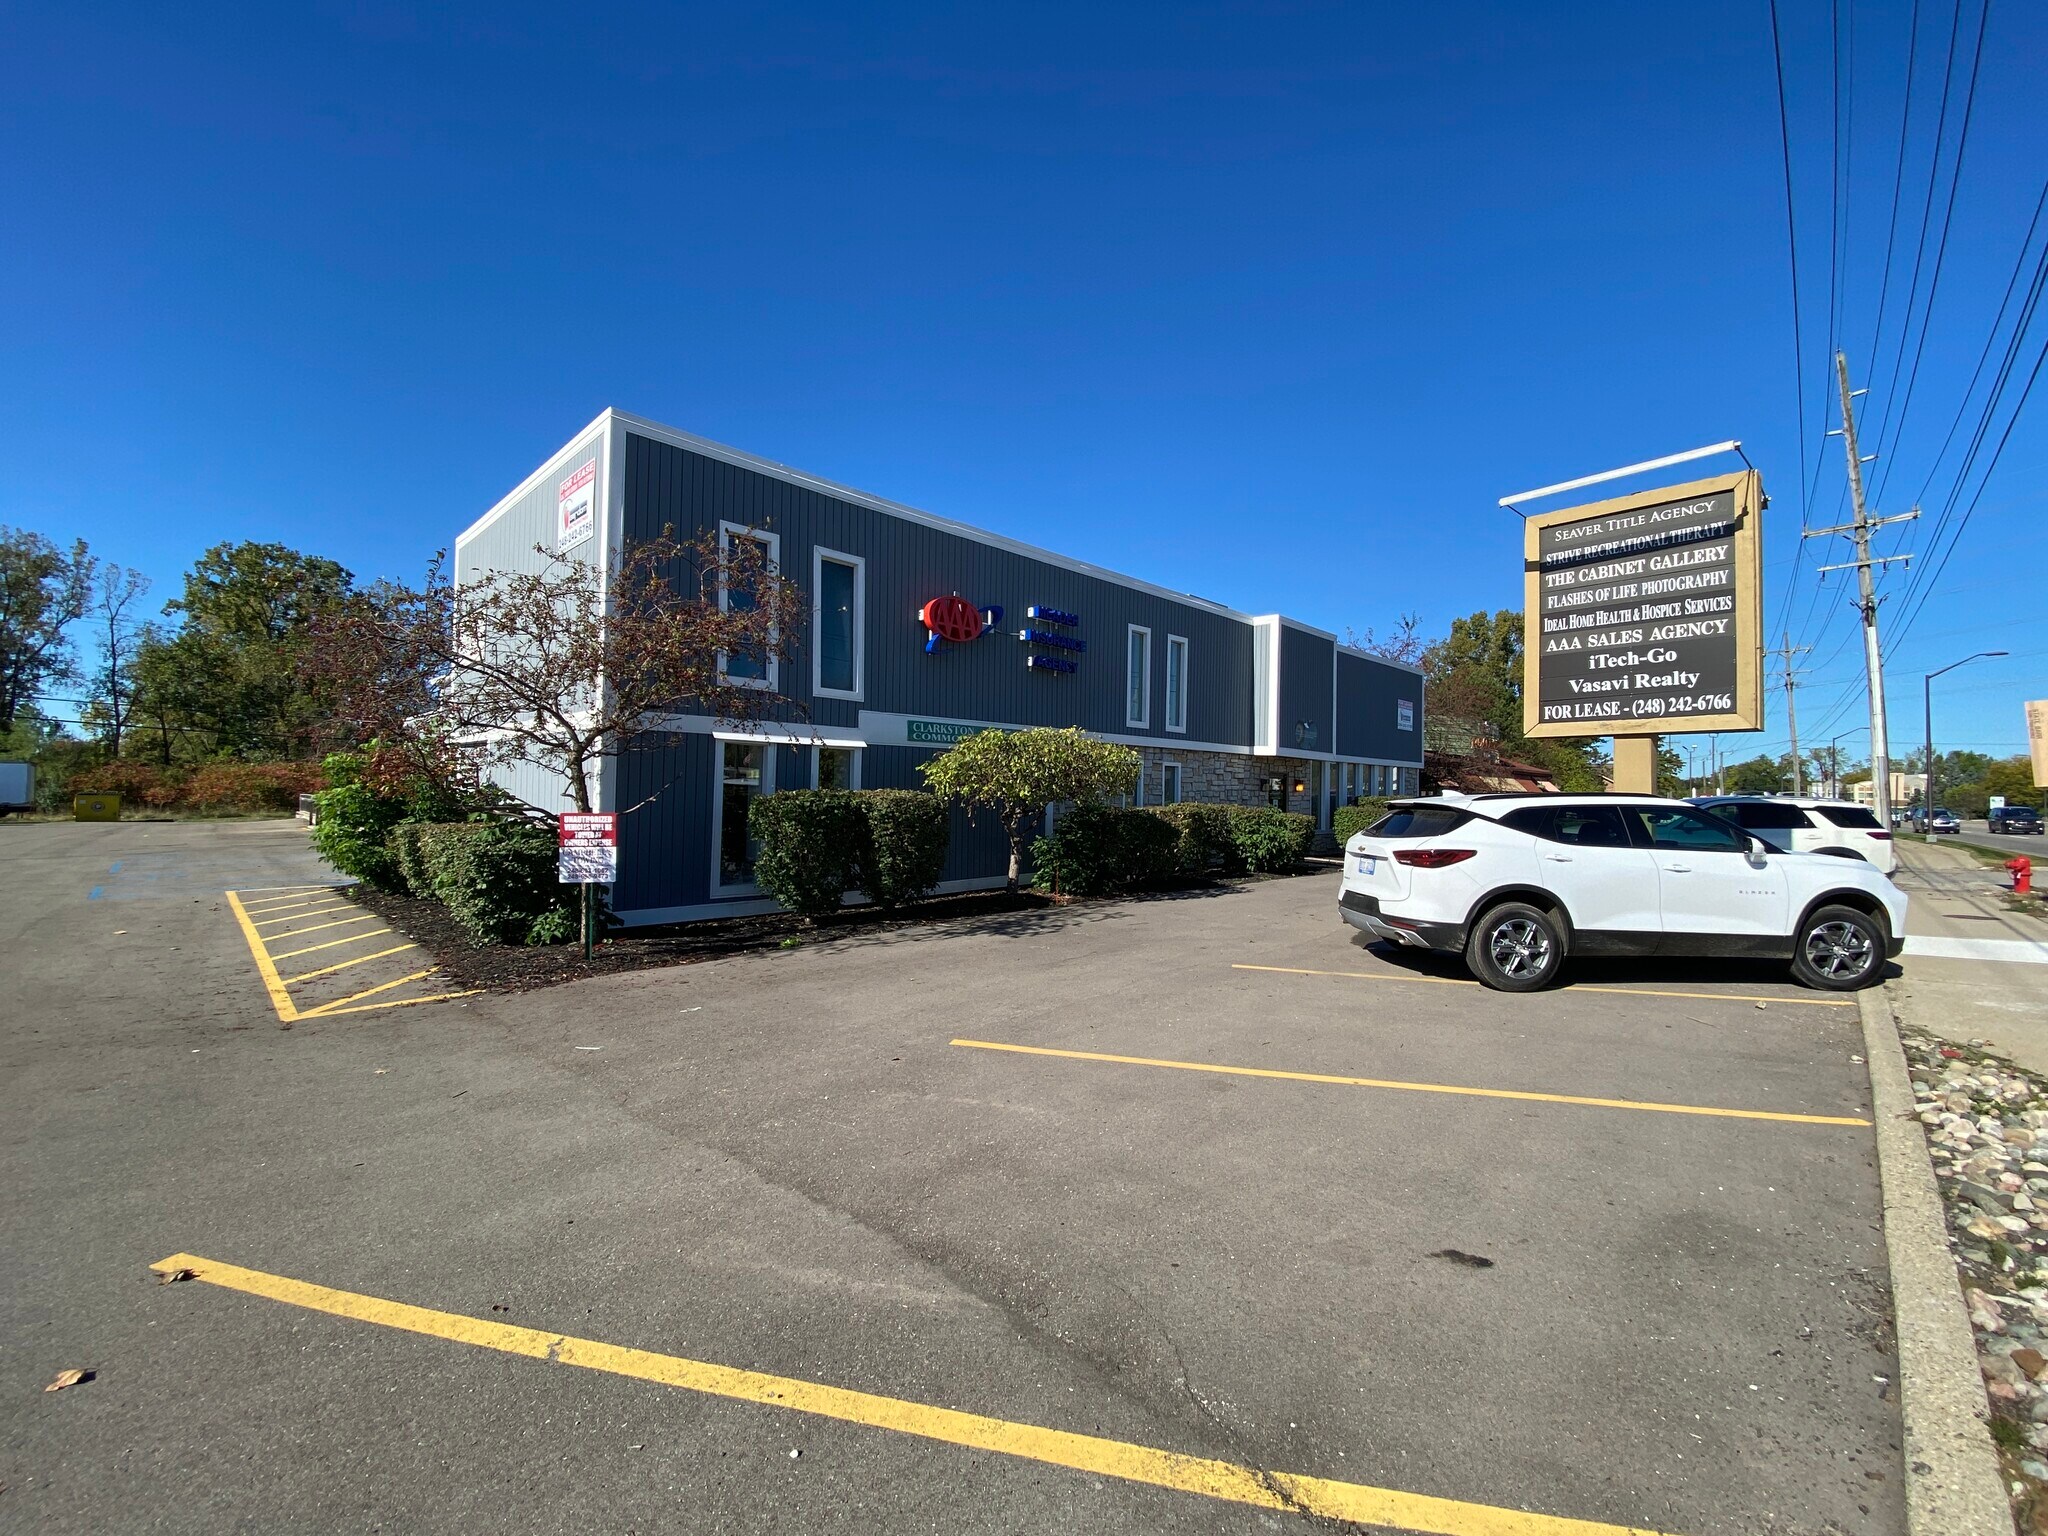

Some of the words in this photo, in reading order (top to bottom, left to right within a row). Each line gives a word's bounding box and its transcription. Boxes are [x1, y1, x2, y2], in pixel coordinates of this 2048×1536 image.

[560, 478, 573, 492] FOR
[573, 462, 595, 484] LEASE
[1555, 523, 1603, 542] SEAVER
[1605, 515, 1646, 532] TITLE
[1649, 500, 1716, 523] AGENCY
[1546, 547, 1582, 567] STRIVE
[1584, 531, 1669, 560] RECREATIONAL
[1669, 520, 1727, 544] THERAPY
[1545, 570, 1575, 588] THE
[1578, 558, 1646, 582] CABINET
[1649, 545, 1729, 571] GALLERY
[1547, 590, 1594, 609] FLASHES
[1595, 587, 1611, 602] OF
[1612, 583, 1638, 600] LIFE
[1641, 569, 1729, 596] PHOTOGRAPHY
[930, 597, 982, 641] AAA
[1543, 617, 1569, 633] IDEAL
[1569, 613, 1595, 630] HOME
[1595, 609, 1632, 626] HEALTH
[1632, 607, 1641, 622] &
[1641, 602, 1682, 621] HOSPICE
[1684, 595, 1732, 615] SERVICES
[1030, 629, 1088, 653] INSURANCE
[1546, 636, 1582, 652] AAA
[1587, 629, 1643, 648] SALES
[1649, 618, 1729, 641] AGENCY
[1034, 655, 1079, 673] AGENCY
[1589, 647, 1677, 670] iTech-Go
[1568, 674, 1630, 693] Vasavi
[1634, 670, 1701, 689] Realty
[1543, 704, 1572, 720] FOR
[1574, 701, 1621, 718] LEASE
[1632, 698, 1666, 718] (248)
[1668, 693, 1732, 712] 242-6766
[912, 722, 975, 736] CLARKSTON
[912, 732, 960, 742] COMMO
[563, 815, 613, 823] UNAUTHORIZED
[563, 823, 590, 831] VEHICLES
[590, 823, 604, 831] WILL
[604, 823, 613, 831] BE
[563, 838, 589, 847] OWNERS
[588, 838, 613, 847] EXPENSE
[574, 831, 594, 839] TOWED
